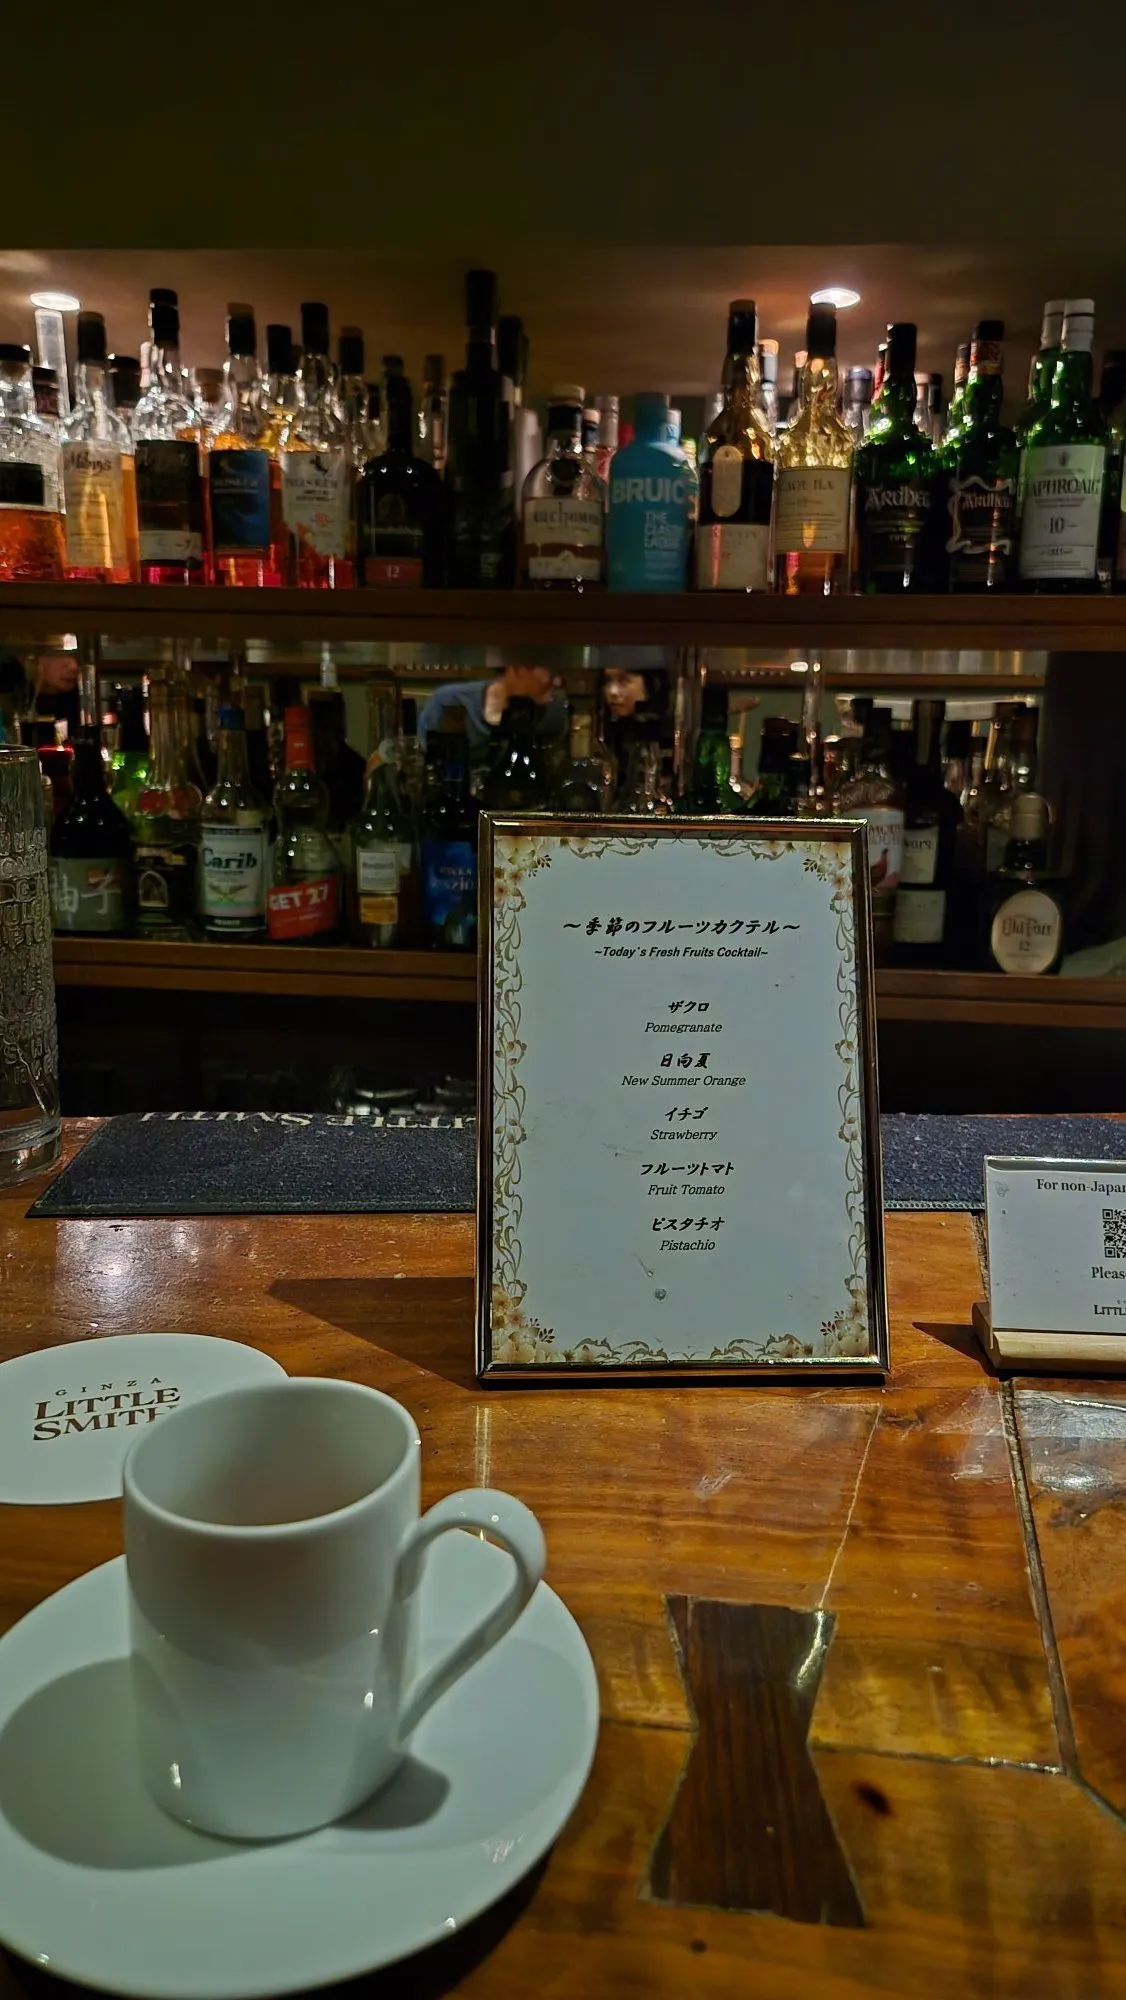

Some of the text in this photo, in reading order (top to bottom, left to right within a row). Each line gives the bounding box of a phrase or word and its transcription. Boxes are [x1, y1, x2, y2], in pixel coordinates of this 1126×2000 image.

[611, 477, 687, 504] BRUIC
[1047, 516, 1065, 534] 10
[202, 846, 257, 871] Carib
[268, 883, 330, 912] GET 27
[648, 946, 680, 958] Fresh
[682, 946, 715, 958] Fruits
[667, 999, 710, 1014] ザクロ
[644, 1022, 723, 1034] Pomegranate
[659, 1051, 711, 1069] 日向夏
[621, 1075, 746, 1087] New Summer Orange
[326, 1114, 477, 1129] ITTLE
[664, 1106, 709, 1122] イチゴ
[649, 1129, 718, 1141] Strawberry
[639, 1161, 735, 1177] フルーツトマト
[647, 1184, 726, 1196] Fruit Tomato
[1036, 1178, 1059, 1191] For
[651, 1216, 726, 1232] ピスタチオ
[659, 1239, 716, 1251] Pistachio
[1090, 1266, 1126, 1280] Pleas
[1093, 1304, 1126, 1317] LITTL
[54, 1377, 163, 1397] GINZA
[33, 1387, 182, 1421] LITTLE
